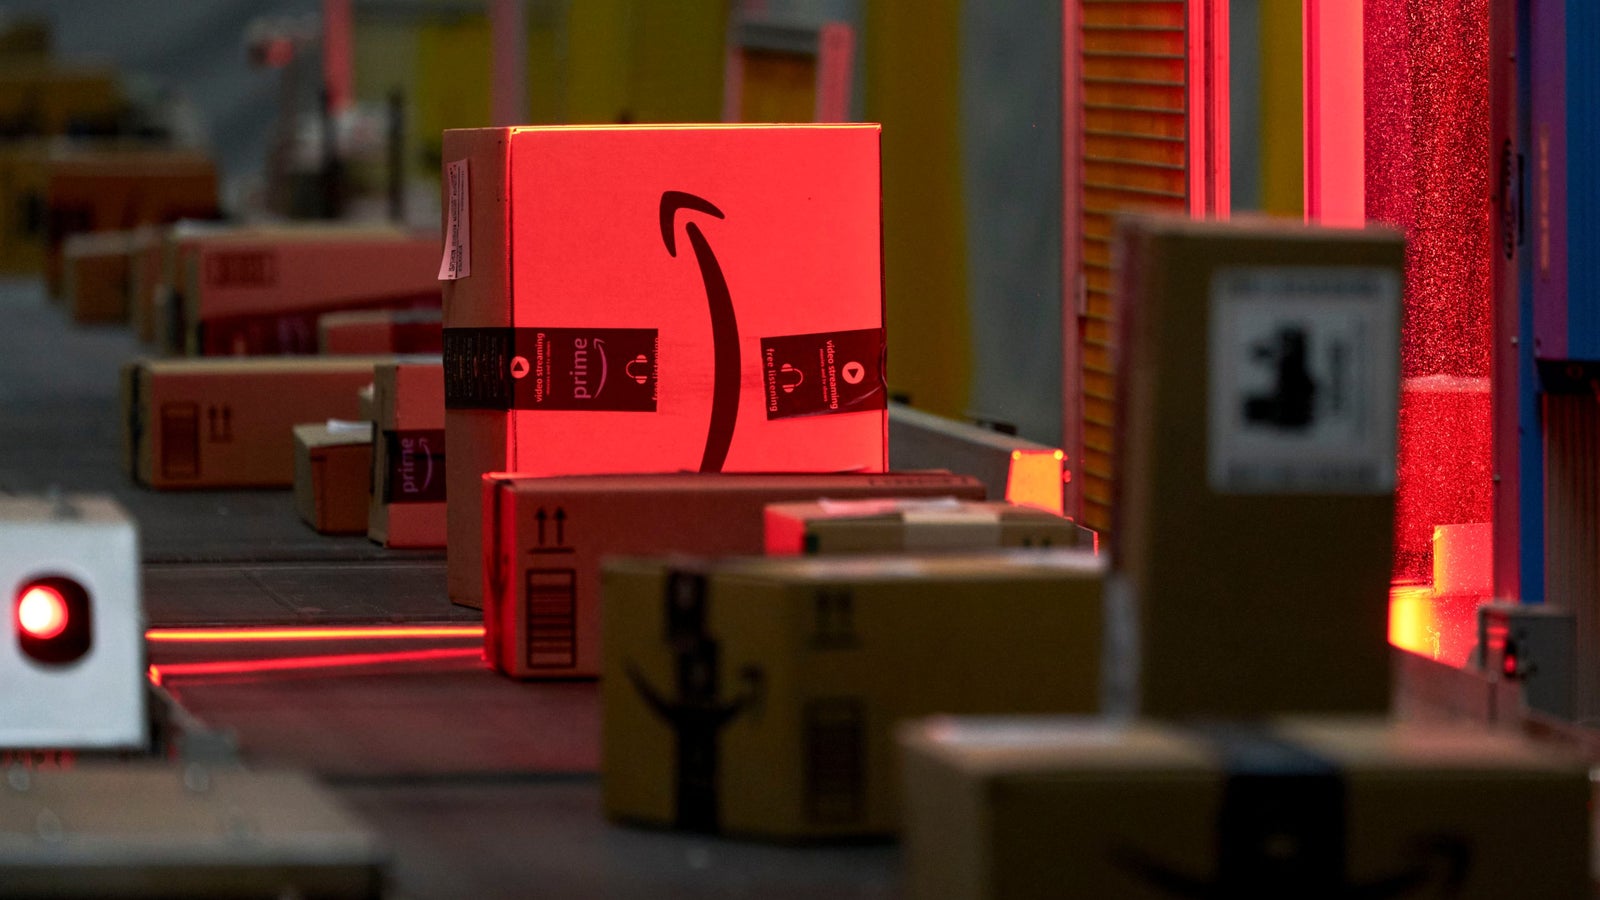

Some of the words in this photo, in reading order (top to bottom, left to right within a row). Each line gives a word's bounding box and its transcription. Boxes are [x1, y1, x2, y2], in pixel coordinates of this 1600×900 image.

[534, 332, 545, 377] streaming
[569, 338, 591, 399] prime
[766, 348, 775, 367] free
[826, 340, 835, 364] video
[534, 378, 543, 402] video
[768, 370, 778, 412] listening
[829, 366, 840, 409] streaming
[397, 438, 419, 493] prime
